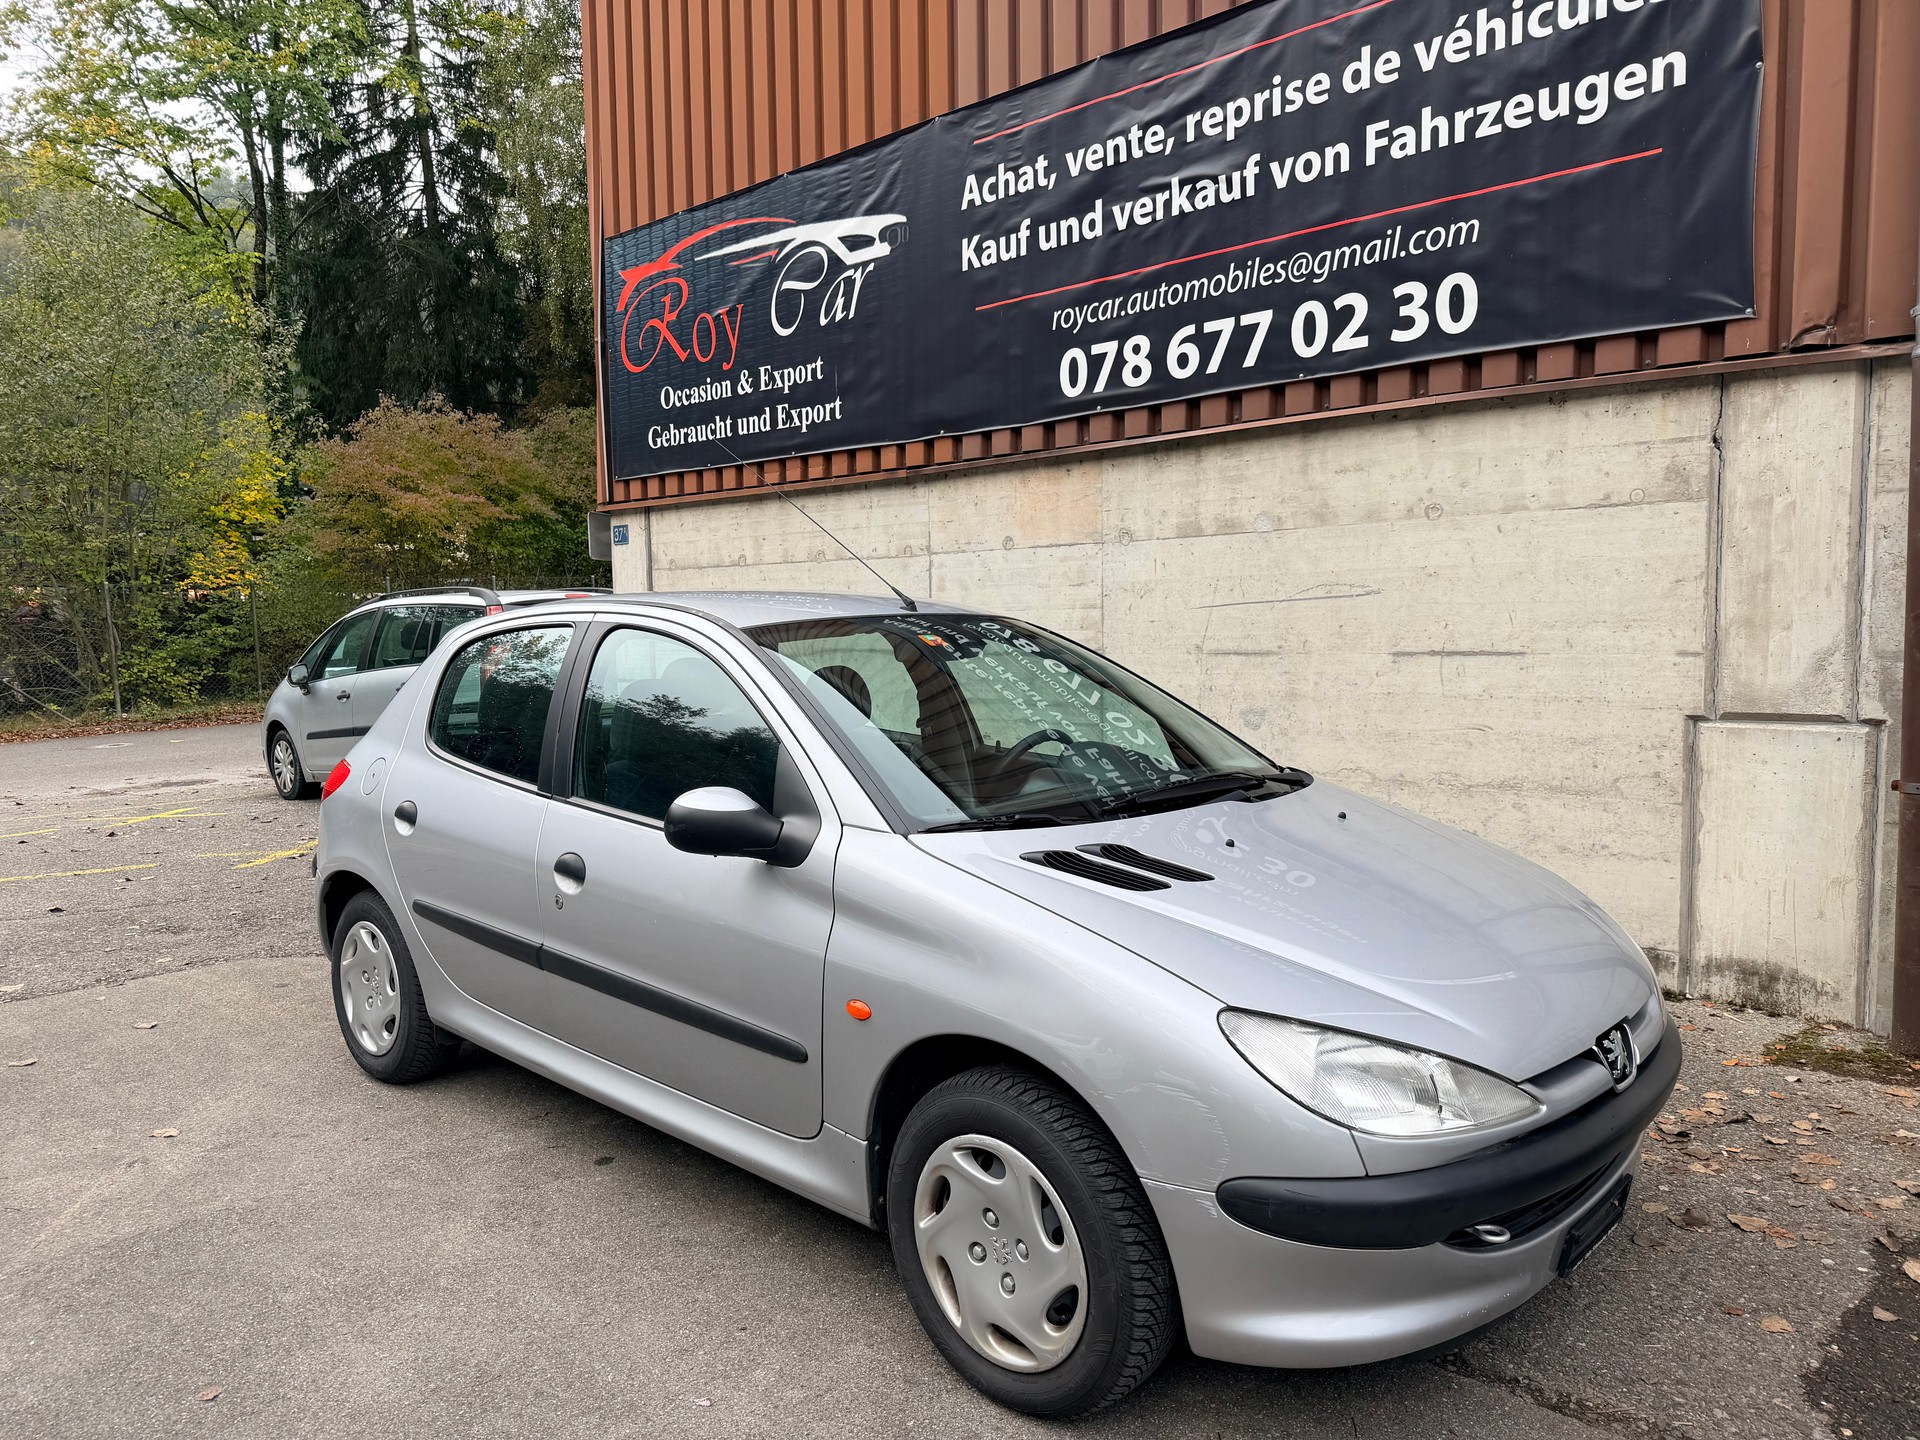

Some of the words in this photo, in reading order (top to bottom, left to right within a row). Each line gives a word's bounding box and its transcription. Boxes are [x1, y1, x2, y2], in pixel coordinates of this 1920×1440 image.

[961, 154, 1057, 210] Achat,
[1065, 124, 1176, 178] vente,
[1187, 73, 1331, 142] reprise
[1343, 45, 1401, 93] de
[962, 218, 1031, 271] Kauf
[1039, 199, 1103, 252] und
[1112, 153, 1261, 230] verkauf
[1270, 143, 1350, 190] von
[1366, 50, 1687, 166] Fahrzeugen
[620, 277, 744, 373] Roy
[771, 245, 875, 337] Car
[1052, 218, 1480, 334] roycar.automobiles@gmail.com
[1059, 335, 1153, 398] 078
[1166, 309, 1274, 380] 677
[1290, 293, 1369, 359] 02
[1391, 272, 1479, 343] 30
[648, 415, 733, 449] Gebraucht
[737, 407, 771, 436] und
[776, 396, 843, 433] Export
[660, 377, 733, 410] Occasion
[737, 369, 754, 395] &
[759, 356, 824, 395] Export
